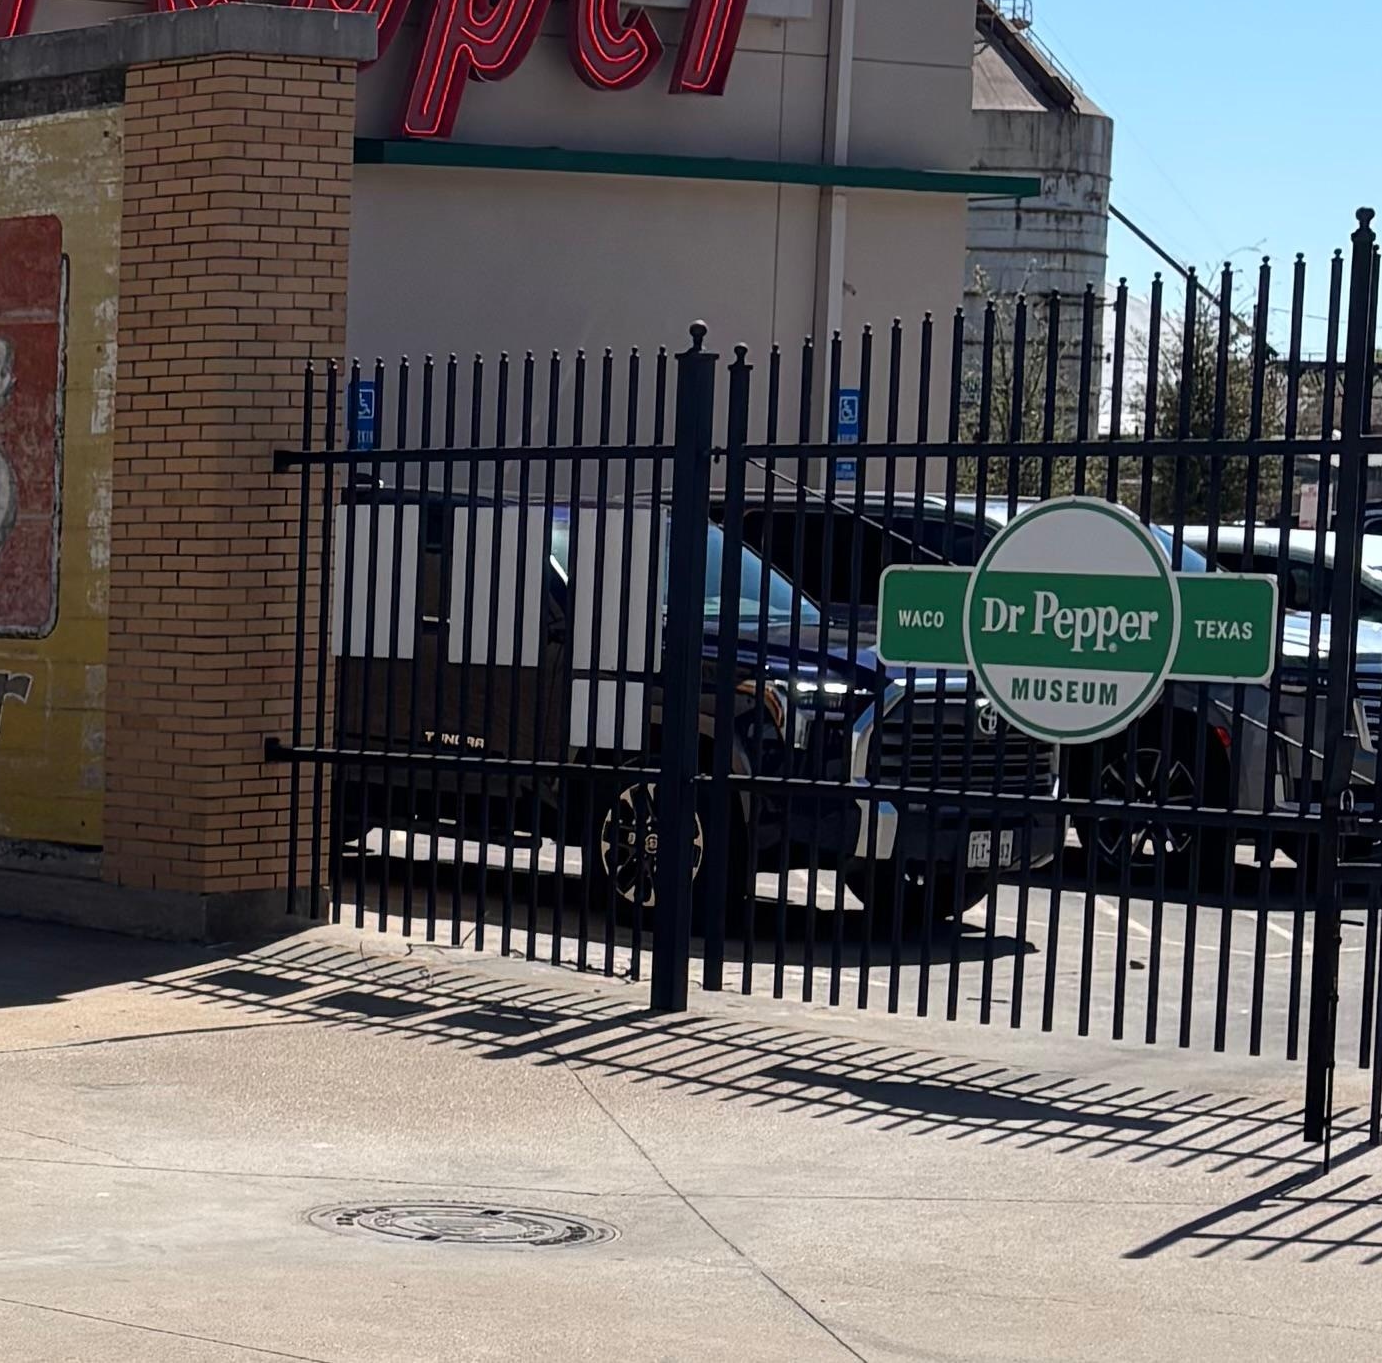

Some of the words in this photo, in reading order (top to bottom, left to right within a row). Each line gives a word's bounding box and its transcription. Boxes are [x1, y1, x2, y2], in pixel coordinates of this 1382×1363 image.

[898, 609, 944, 629] WACO
[981, 596, 1025, 633] Dr
[1194, 619, 1253, 640] TEXAS
[1011, 677, 1118, 706] MUSEUM
